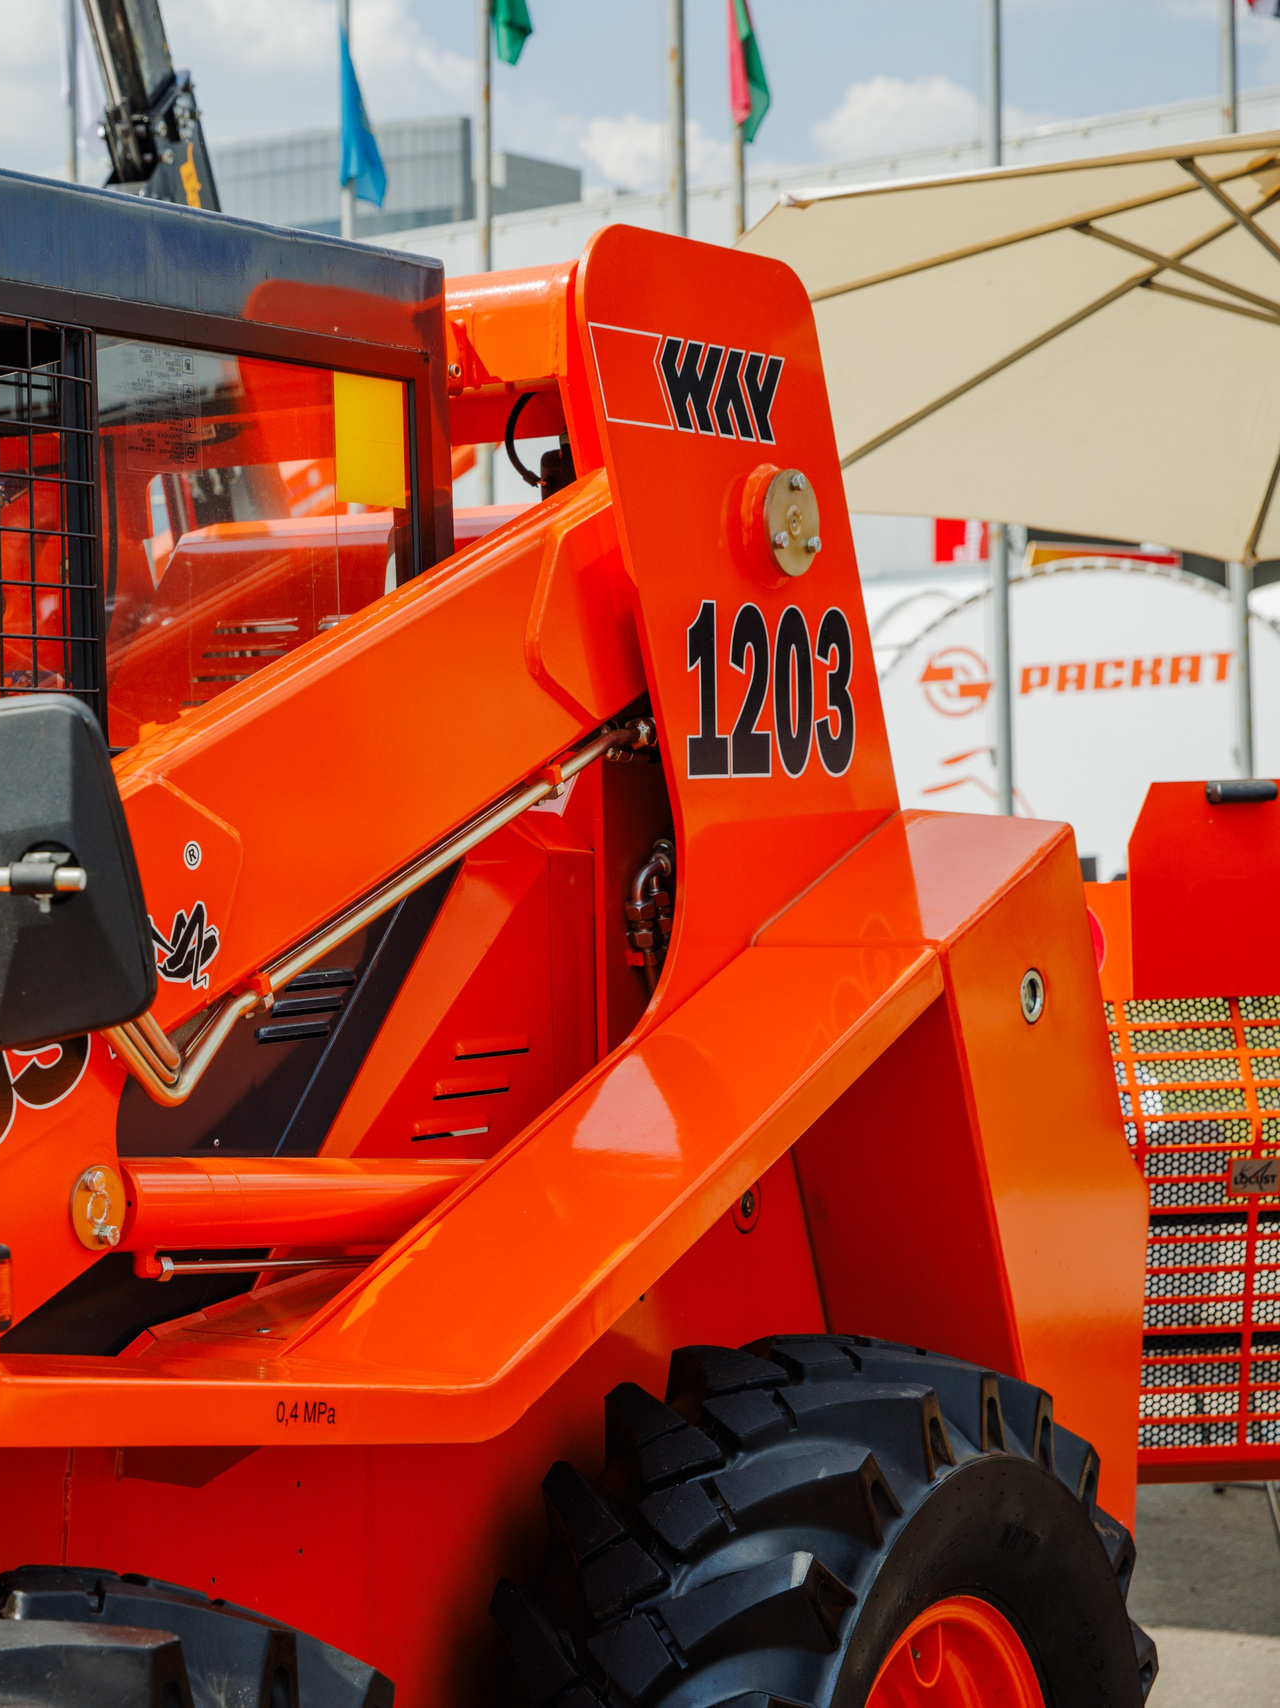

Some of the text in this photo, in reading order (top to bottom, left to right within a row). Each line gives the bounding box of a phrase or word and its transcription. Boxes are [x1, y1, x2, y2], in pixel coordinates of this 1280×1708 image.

[659, 336, 785, 445] WAY
[687, 600, 856, 780] 1203
[1233, 1174, 1277, 1186] LOCUST
[276, 1401, 336, 1427] 0,4 MPa
